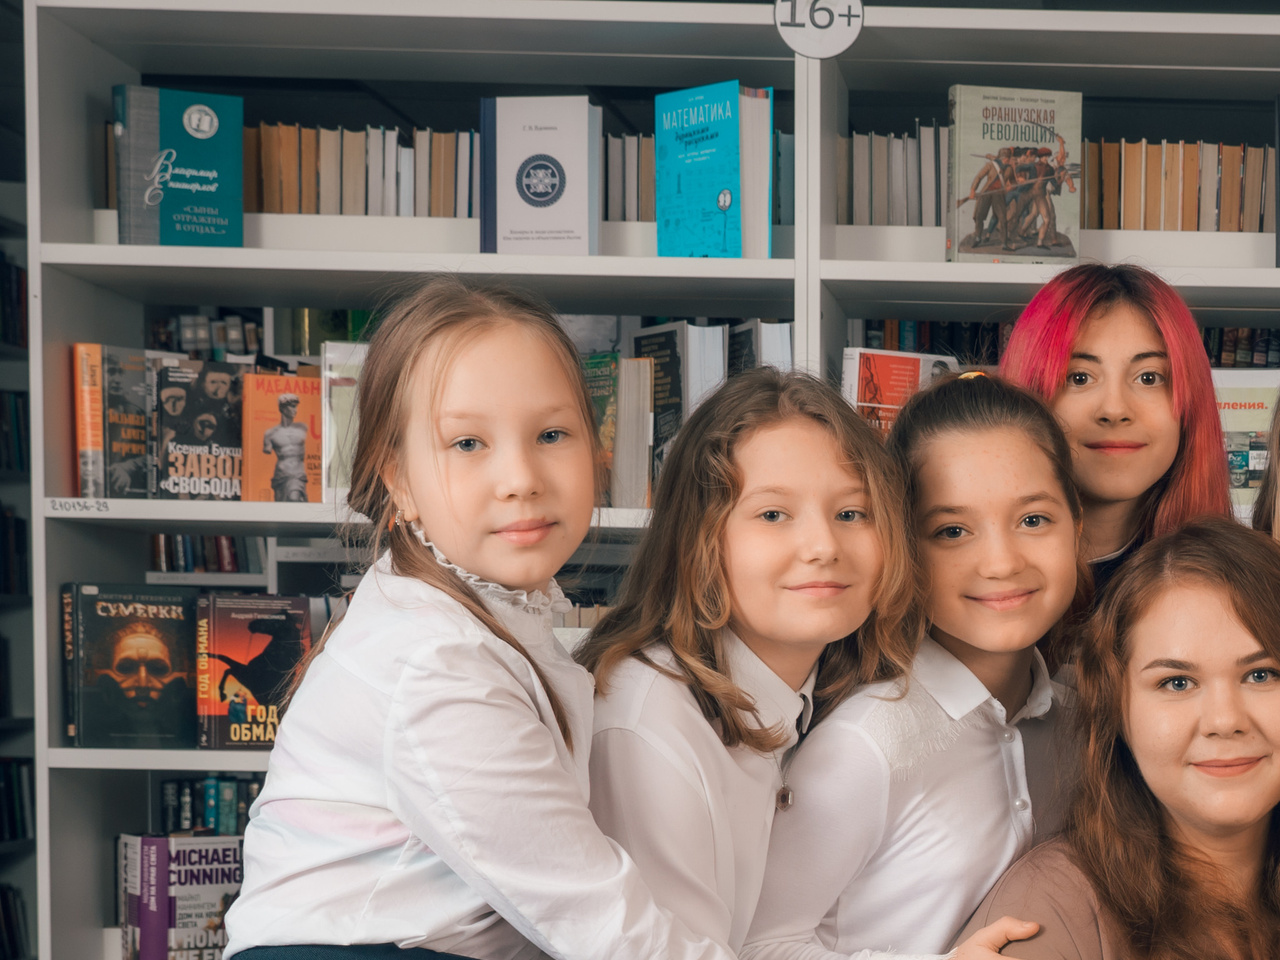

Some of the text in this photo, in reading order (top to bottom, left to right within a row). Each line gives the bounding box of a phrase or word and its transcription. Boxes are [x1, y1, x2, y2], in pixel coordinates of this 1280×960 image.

[780, 0, 861, 29] 16+
[663, 100, 732, 130] МАТЕМАТИКА
[982, 106, 1055, 125] ФРАНЦУЗСКАЯ
[982, 123, 1055, 145] РЕВОЛЮЦИЯ
[172, 214, 229, 225] ОТРАЖЕНЫ
[175, 223, 181, 231] В
[255, 378, 320, 396] ИДЕАЛЬН
[121, 427, 146, 441] книга
[168, 442, 209, 456] Ксения
[160, 477, 241, 498] «СВОБОДА
[96, 601, 185, 620] СУМЕРКИ
[62, 593, 73, 660] СУМЕРКИ
[198, 618, 208, 670] ОБМАНА
[199, 674, 209, 698] ГОД
[247, 705, 279, 725] ГОД
[230, 724, 278, 741] ОБМА
[168, 848, 240, 866] MICHAEL
[168, 867, 242, 886] CUNNING
[177, 921, 198, 929] СВЕТА
